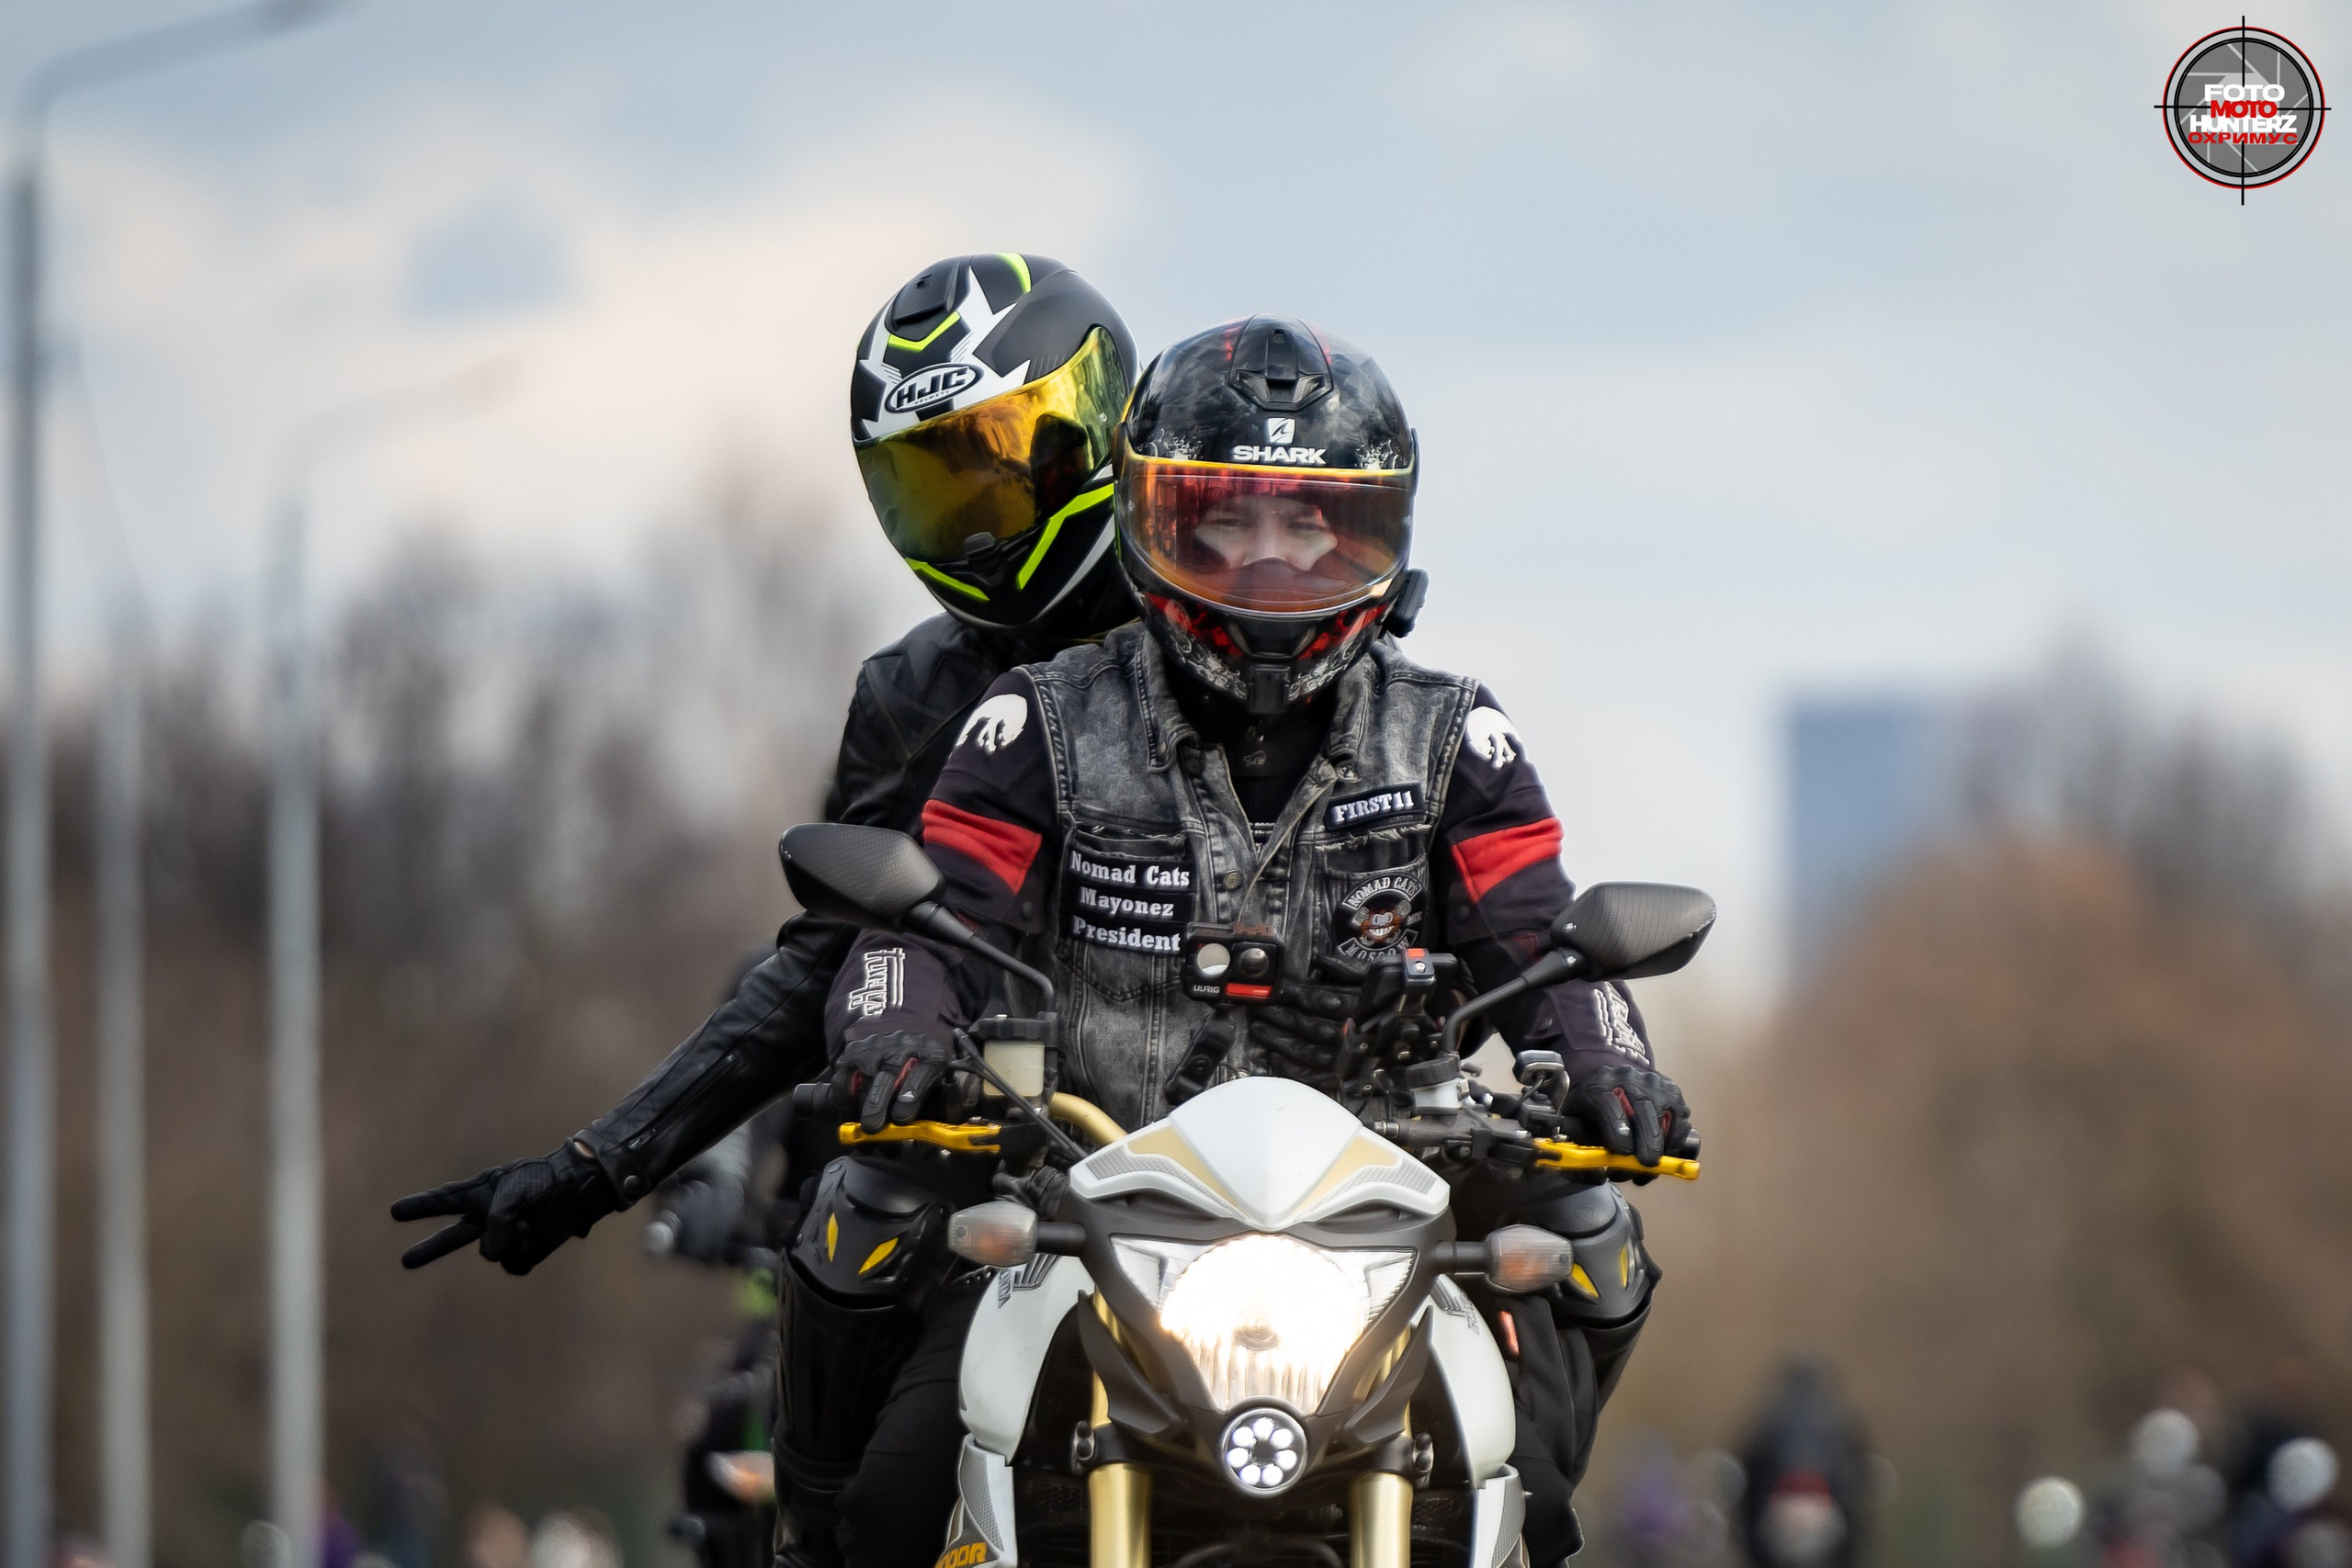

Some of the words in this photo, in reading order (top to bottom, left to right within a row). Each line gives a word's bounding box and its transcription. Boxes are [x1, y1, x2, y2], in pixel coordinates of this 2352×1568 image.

[896, 367, 967, 410] HJC
[1233, 446, 1327, 464] SHARK
[1334, 790, 1414, 822] FIRST11
[1070, 851, 1136, 884] Nomad
[1146, 865, 1190, 886] Cats
[1080, 886, 1174, 917] Mayonez
[1348, 876, 1391, 908] NOMAD
[1394, 876, 1418, 897] CATS
[1072, 915, 1182, 952] President
